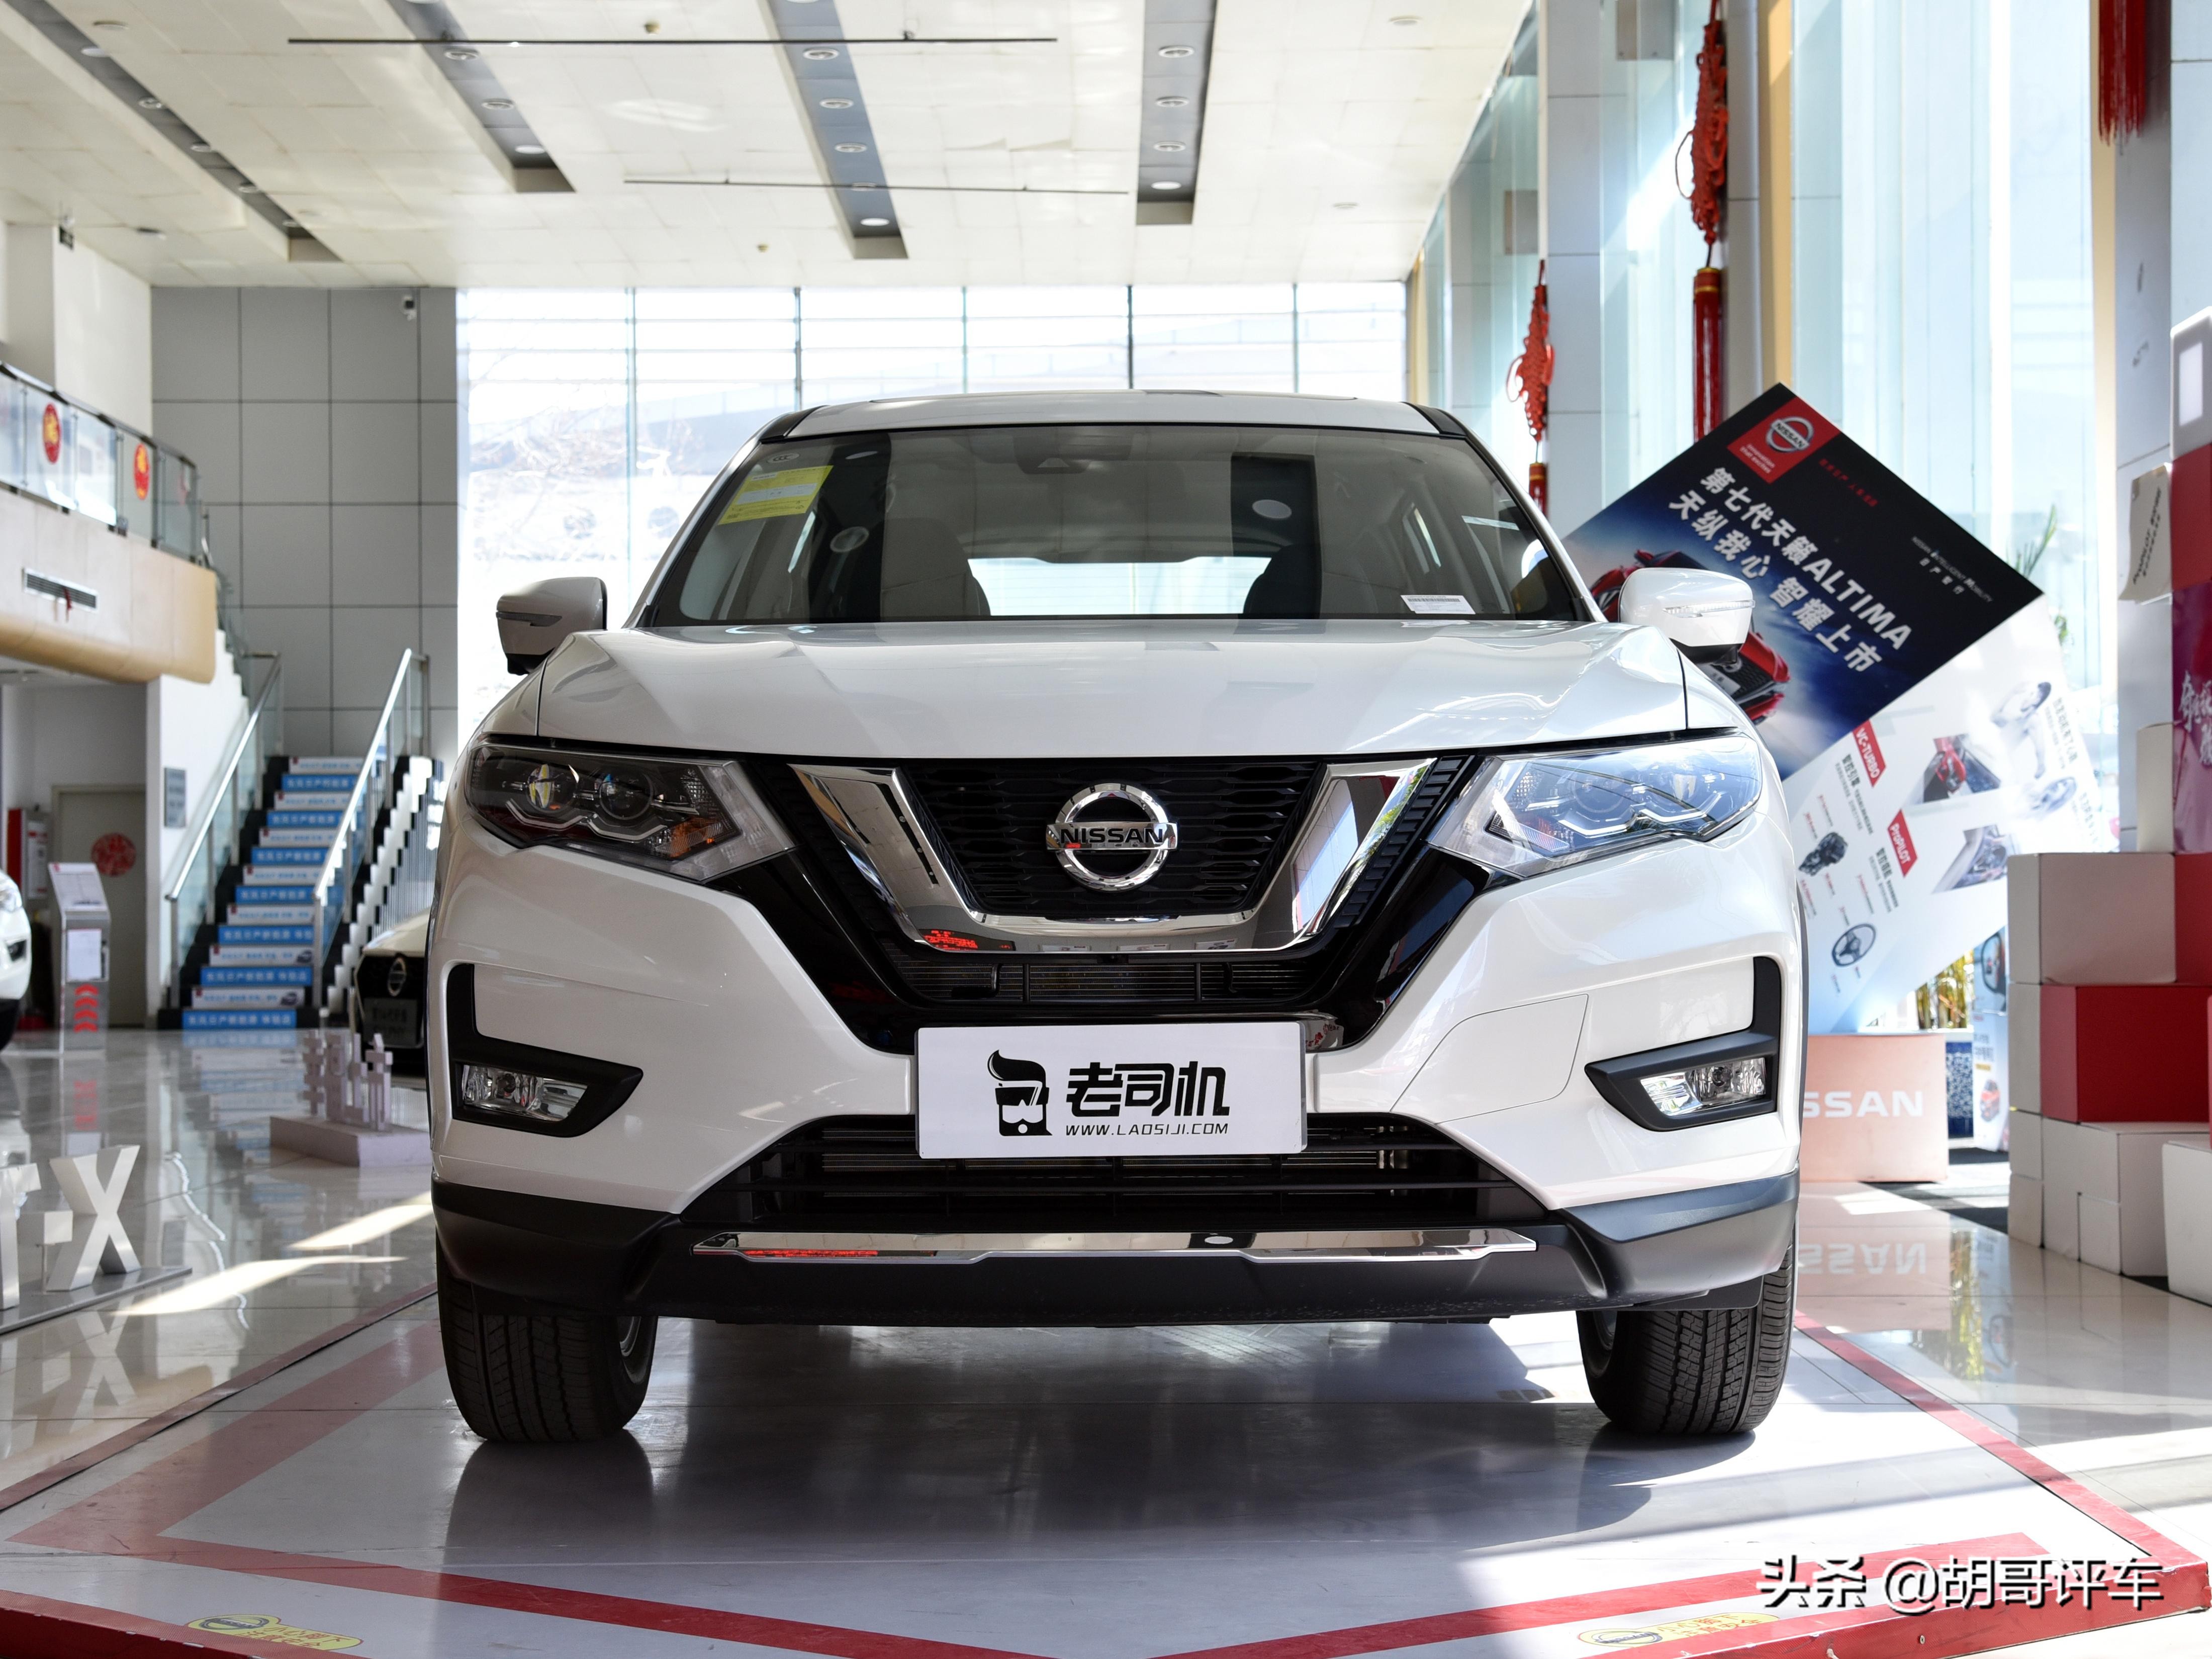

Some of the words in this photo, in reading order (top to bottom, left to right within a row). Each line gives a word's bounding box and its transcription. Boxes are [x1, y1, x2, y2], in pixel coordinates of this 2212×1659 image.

[1777, 423, 1806, 447] NISSAN
[1669, 490, 1771, 579] 天纵我心
[1770, 577, 1882, 672] 智耀上市
[1856, 727, 1881, 779] VC-TURBO
[1060, 828, 1163, 844] NISSAN
[1890, 823, 1910, 864] ProPILOT
[1066, 1061, 1230, 1117] 老司机
[1066, 1123, 1228, 1136] WWW.LAOSIJI.COM
